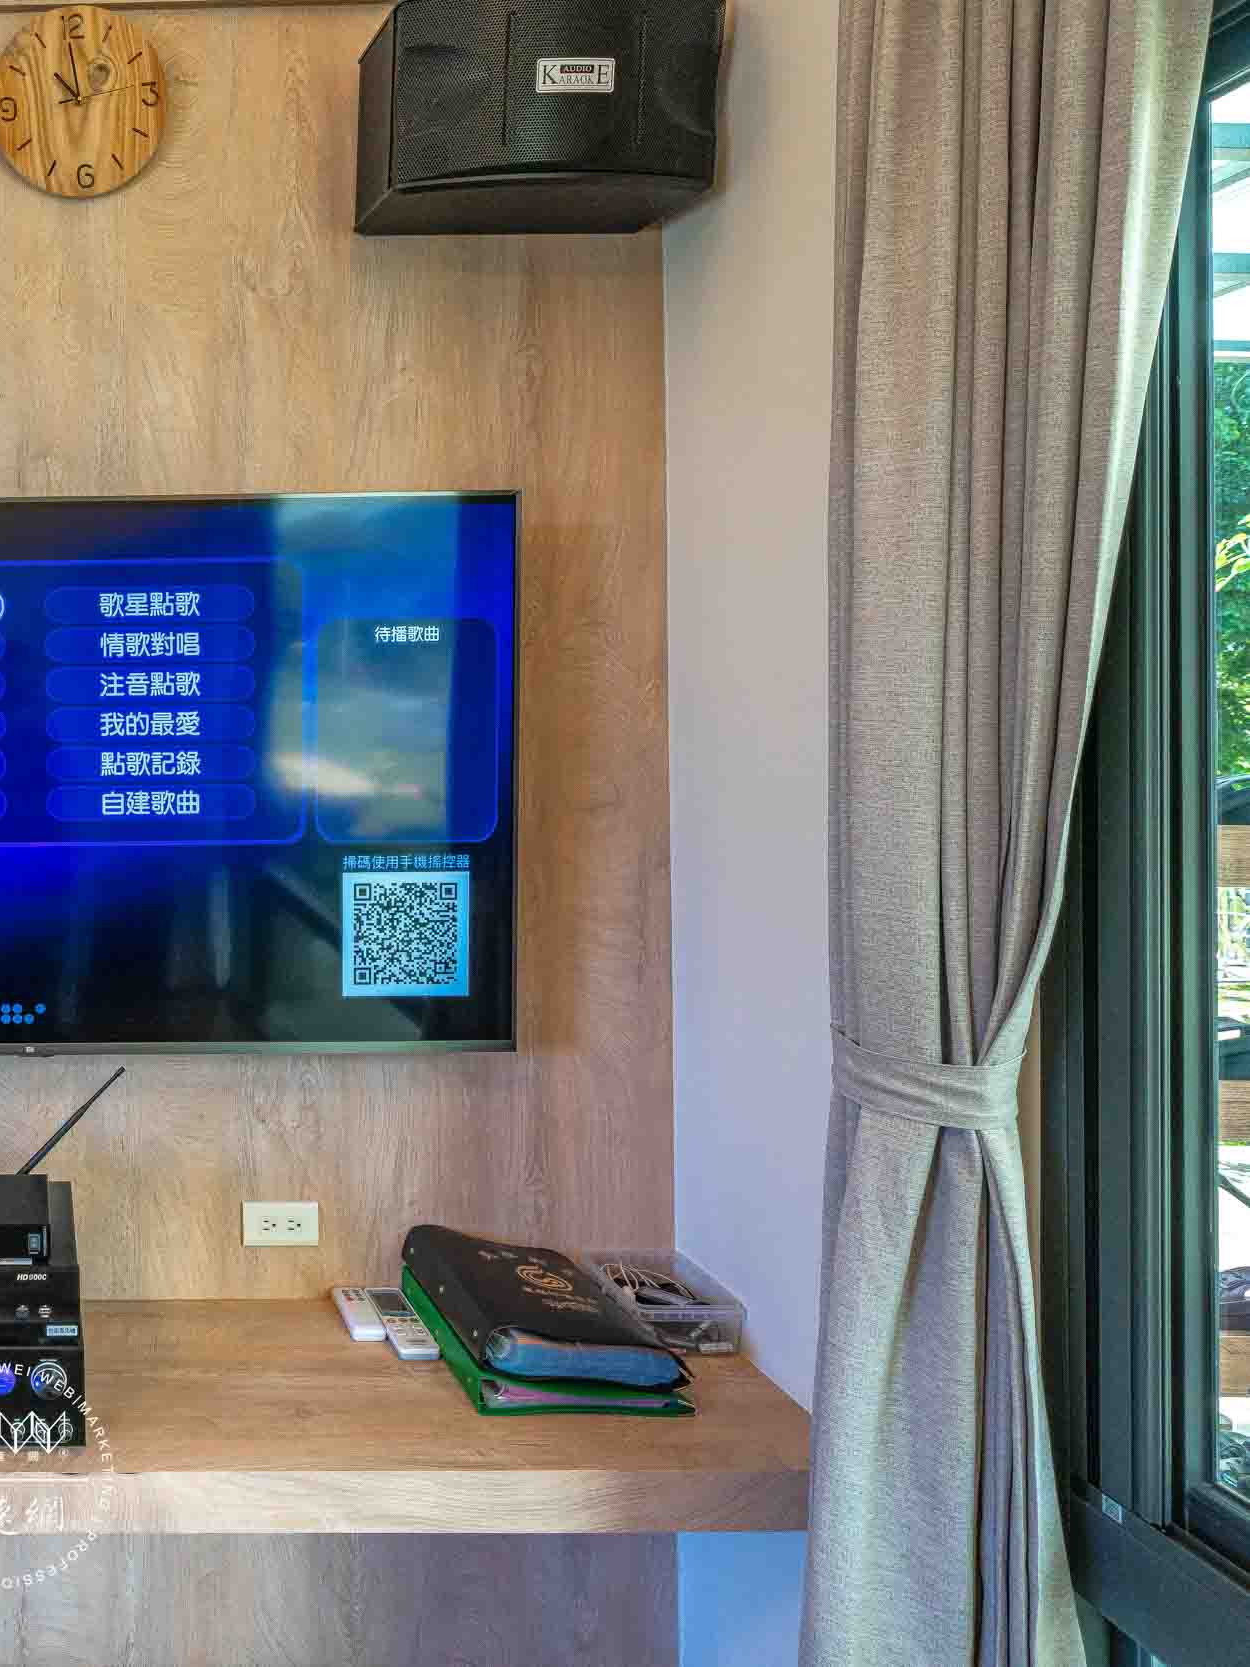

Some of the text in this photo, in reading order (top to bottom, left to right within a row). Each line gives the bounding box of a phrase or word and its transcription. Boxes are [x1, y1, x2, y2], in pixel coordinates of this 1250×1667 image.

[61, 14, 85, 41] 12
[541, 64, 610, 85] KARAOKE
[141, 81, 160, 107] 3
[77, 163, 95, 189] 6
[99, 591, 201, 617] 歌星點歌
[100, 632, 200, 657] 情歌對唱
[374, 625, 440, 642] 待播歌曲
[99, 671, 201, 697] 注音點歌
[100, 711, 201, 737] 我的最愛
[100, 751, 201, 777] 點歌記錄
[102, 790, 200, 816] 自建歌曲
